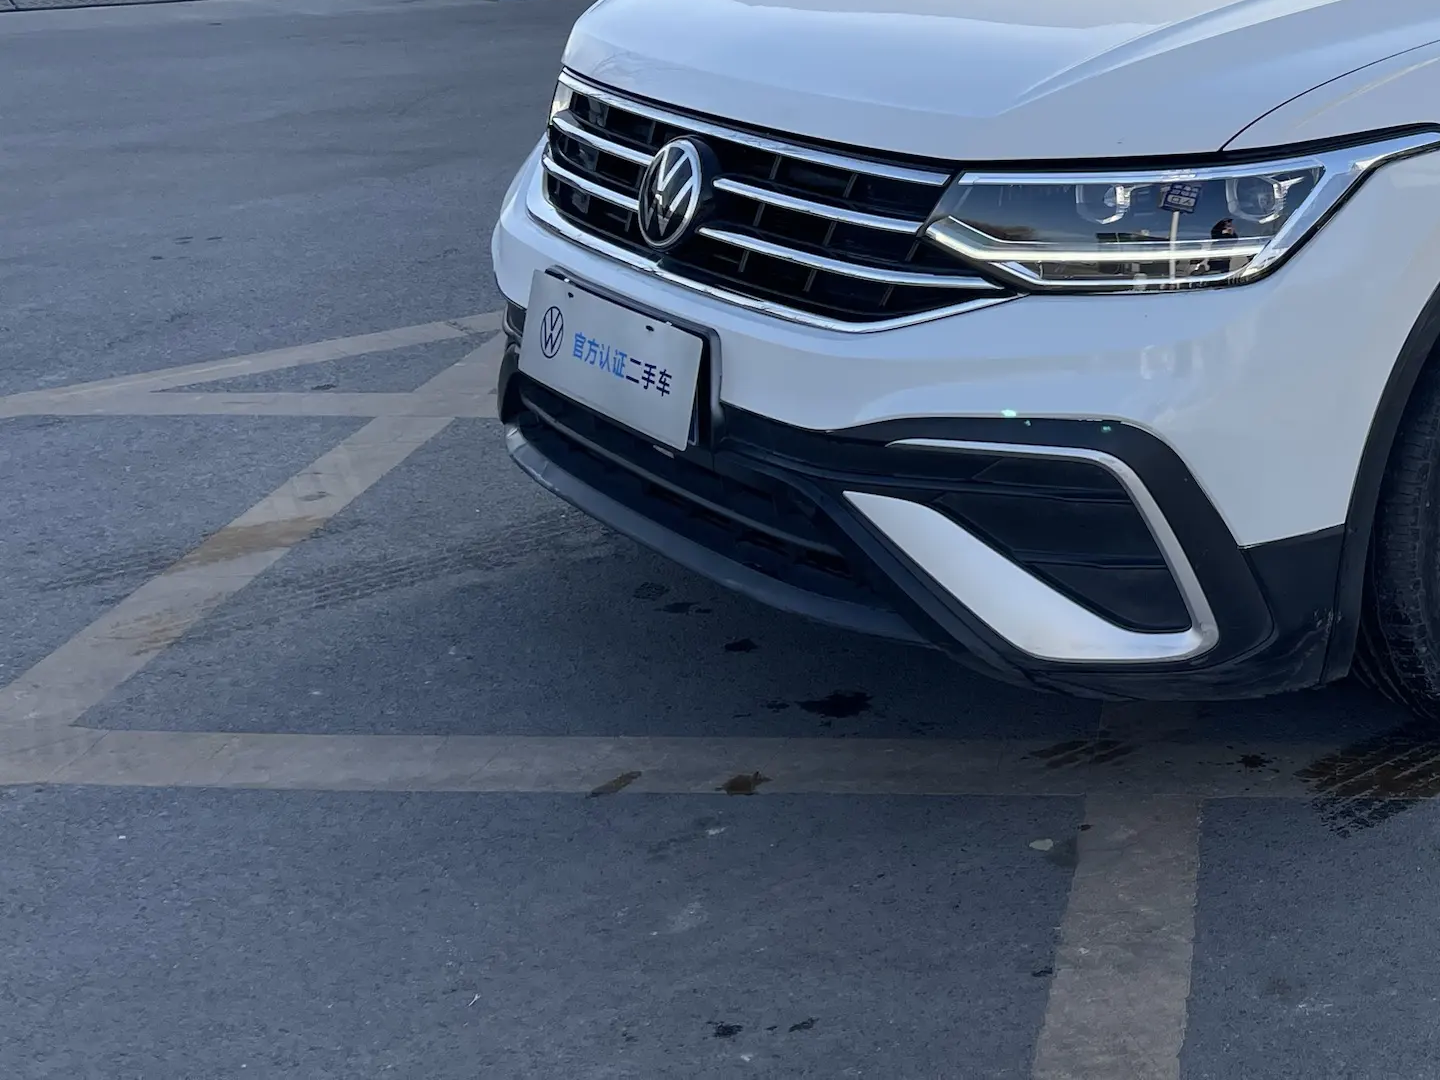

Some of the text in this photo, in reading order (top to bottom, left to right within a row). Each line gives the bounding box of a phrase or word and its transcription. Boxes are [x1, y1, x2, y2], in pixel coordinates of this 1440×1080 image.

[572, 332, 673, 397] 官方认证二手车
